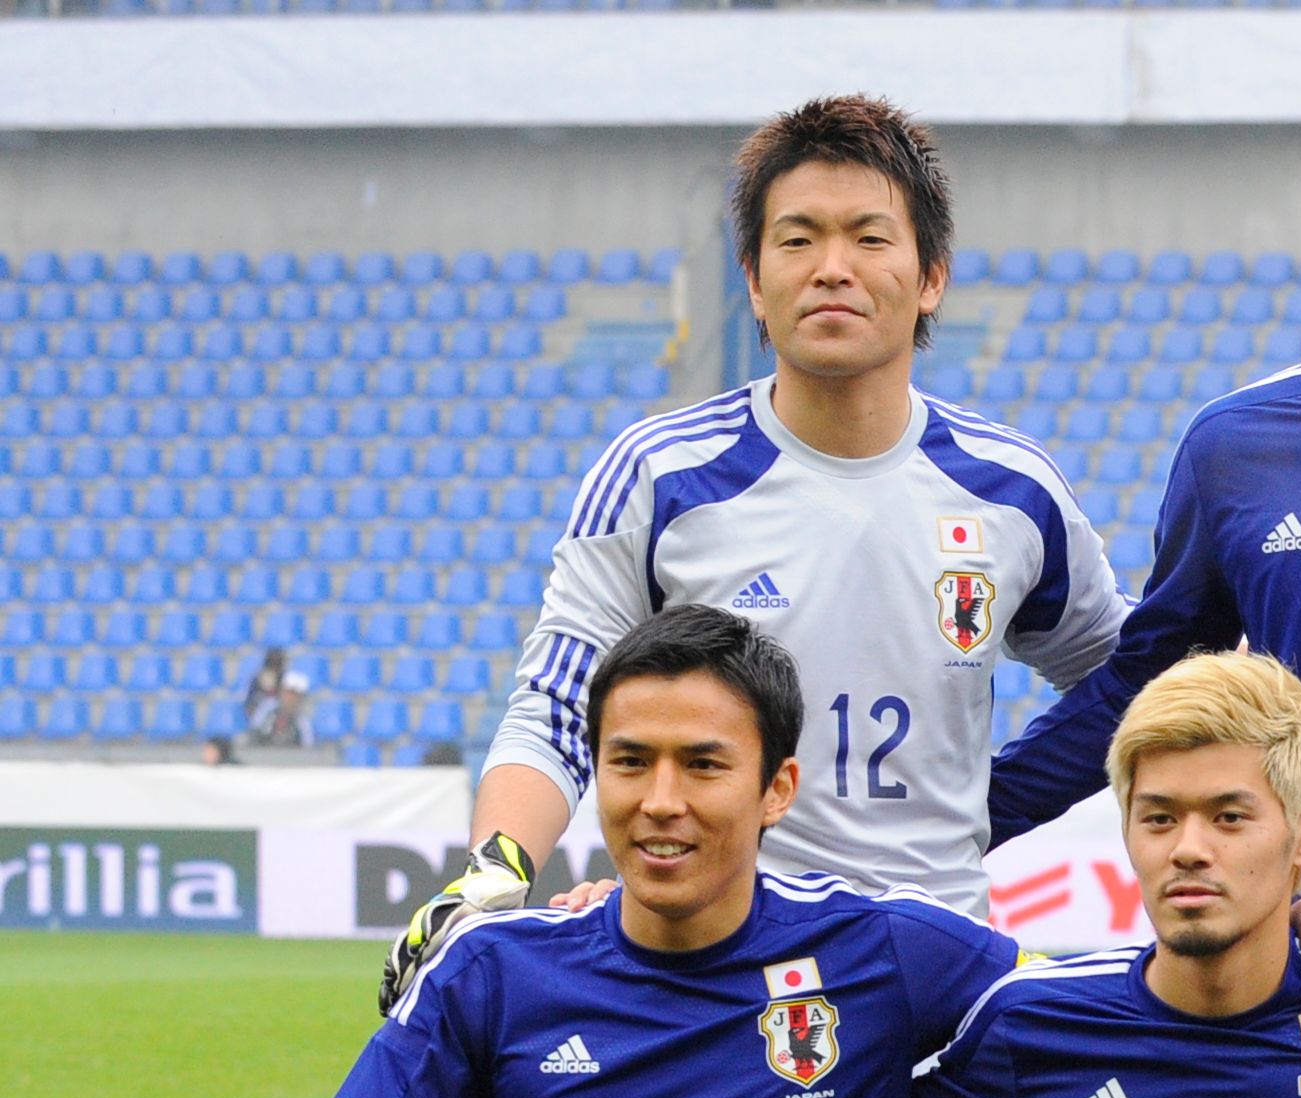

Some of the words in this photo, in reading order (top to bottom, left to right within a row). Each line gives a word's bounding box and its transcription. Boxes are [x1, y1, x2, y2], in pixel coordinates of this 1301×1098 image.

[732, 593, 790, 609] adidas
[829, 693, 911, 800] 12
[539, 1057, 600, 1074] adidas
